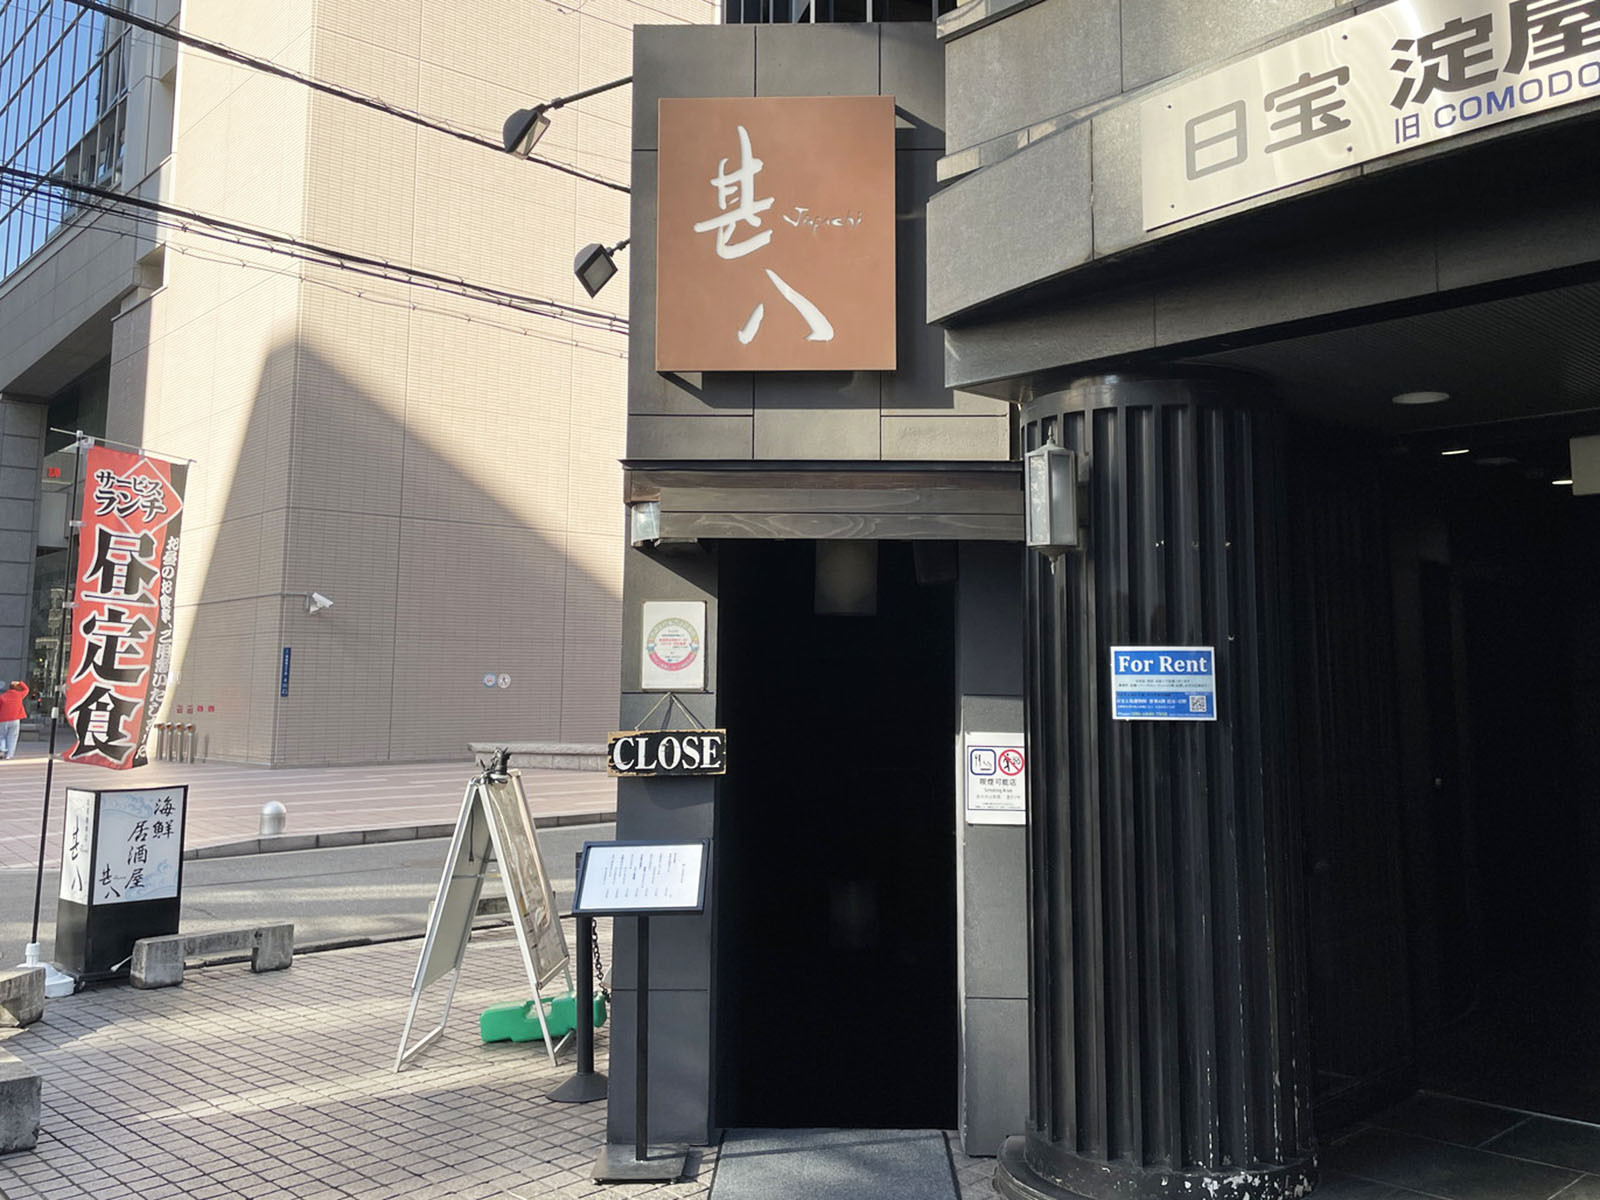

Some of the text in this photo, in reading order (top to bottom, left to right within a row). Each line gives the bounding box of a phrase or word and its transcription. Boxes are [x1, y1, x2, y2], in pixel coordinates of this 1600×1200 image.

[1185, 0, 1600, 181] 日宝 淀屋
[1395, 61, 1600, 144] 旧 COMODO
[693, 125, 835, 345] 甚八
[94, 469, 164, 498] サービス
[94, 488, 168, 523] ランチ
[68, 524, 160, 764] 昼定食
[1118, 655, 1208, 673] For Rent
[613, 736, 722, 771] CLOSE
[152, 795, 176, 839] 海鮮
[125, 819, 150, 890] 居酒屋
